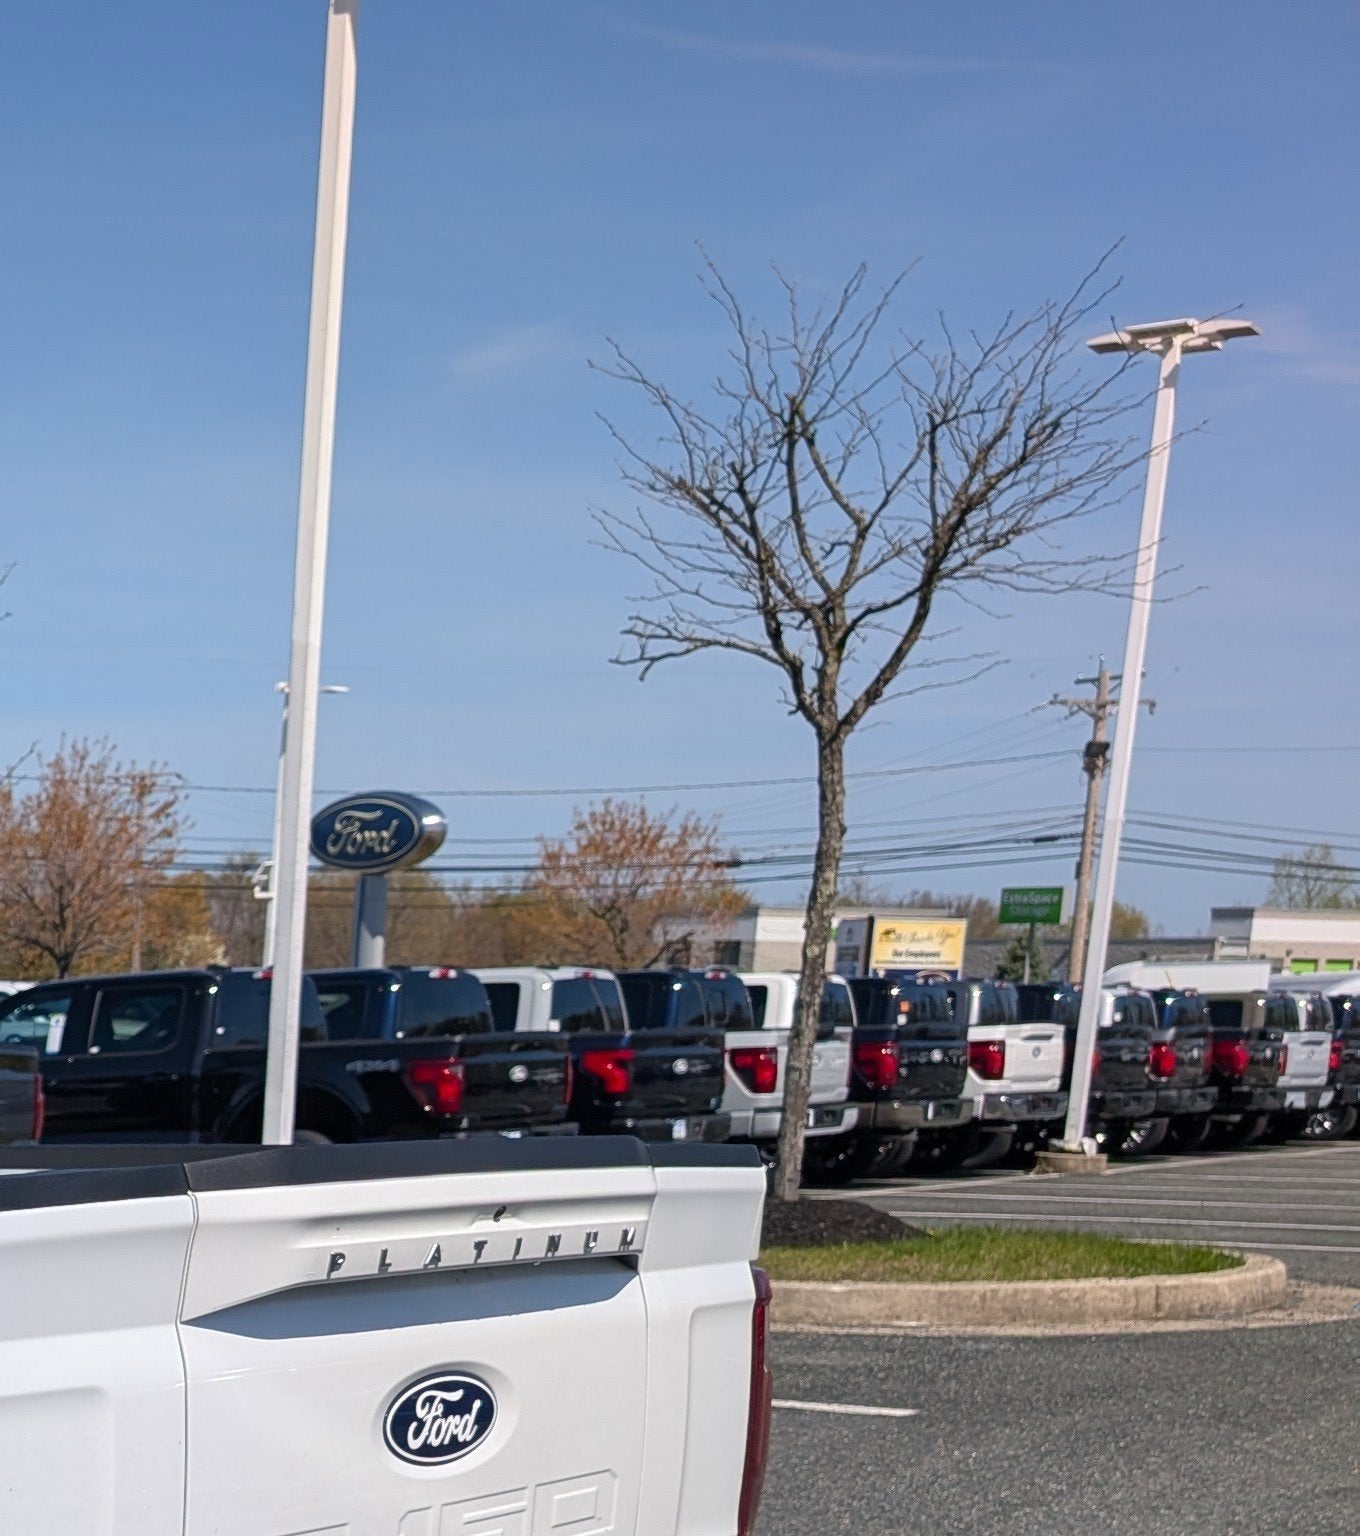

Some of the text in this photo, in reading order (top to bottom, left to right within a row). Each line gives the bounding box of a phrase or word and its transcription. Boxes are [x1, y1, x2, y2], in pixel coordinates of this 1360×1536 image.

[327, 810, 400, 855] Ford
[326, 1225, 637, 1279] PLATINUM
[407, 1388, 484, 1451] Ford
